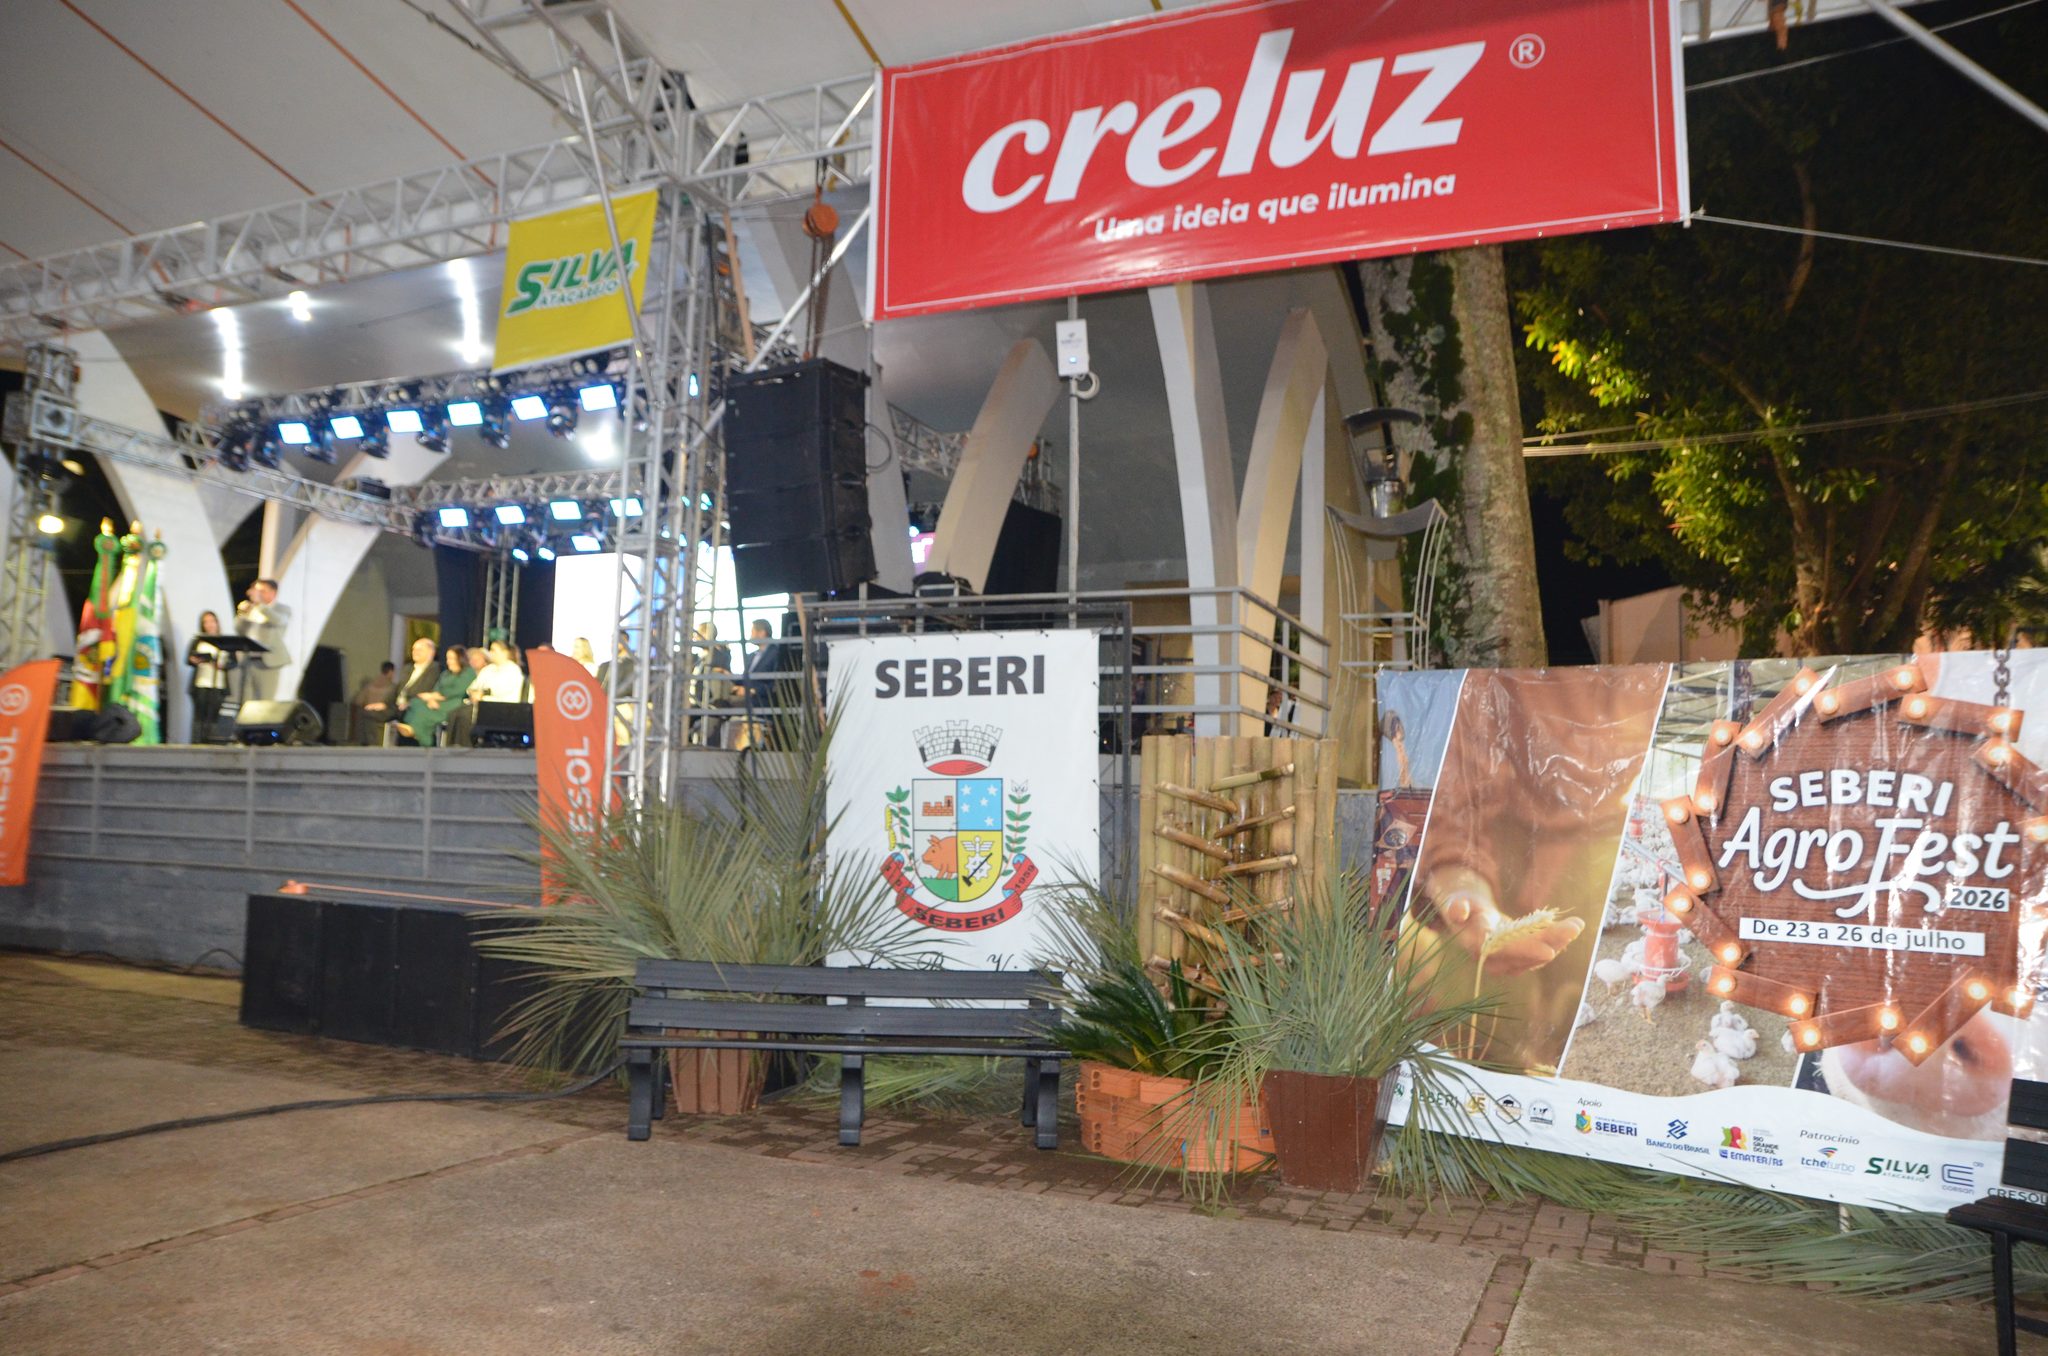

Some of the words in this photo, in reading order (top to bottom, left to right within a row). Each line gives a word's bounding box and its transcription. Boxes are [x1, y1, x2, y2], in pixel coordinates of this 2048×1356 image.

[962, 28, 1486, 214] creluz
[1095, 216, 1165, 242] Uma
[1172, 198, 1250, 232] ideia
[1258, 193, 1320, 225] que
[1327, 172, 1457, 210] ilumina
[505, 239, 638, 317] SILVA
[875, 655, 1045, 699] SEBERI
[565, 735, 595, 848] ESOL
[1769, 769, 1954, 816] SEBERI
[1949, 887, 2007, 910] 2026
[913, 906, 1006, 929] SEBERI
[1753, 919, 1779, 937] De
[1786, 921, 1811, 939] 23
[1818, 927, 1829, 940] a
[1837, 924, 1863, 943] 26
[1870, 926, 1898, 945] de
[1904, 930, 1966, 951] julho
[1410, 1087, 1459, 1110] EBERI
[1577, 1097, 1602, 1107] Apoio
[1595, 1121, 1638, 1137] SEBERI
[1646, 1138, 1672, 1149] BANCO
[1730, 1151, 1784, 1167] EMATER/RS
[1864, 1156, 1931, 1177] SILVA
